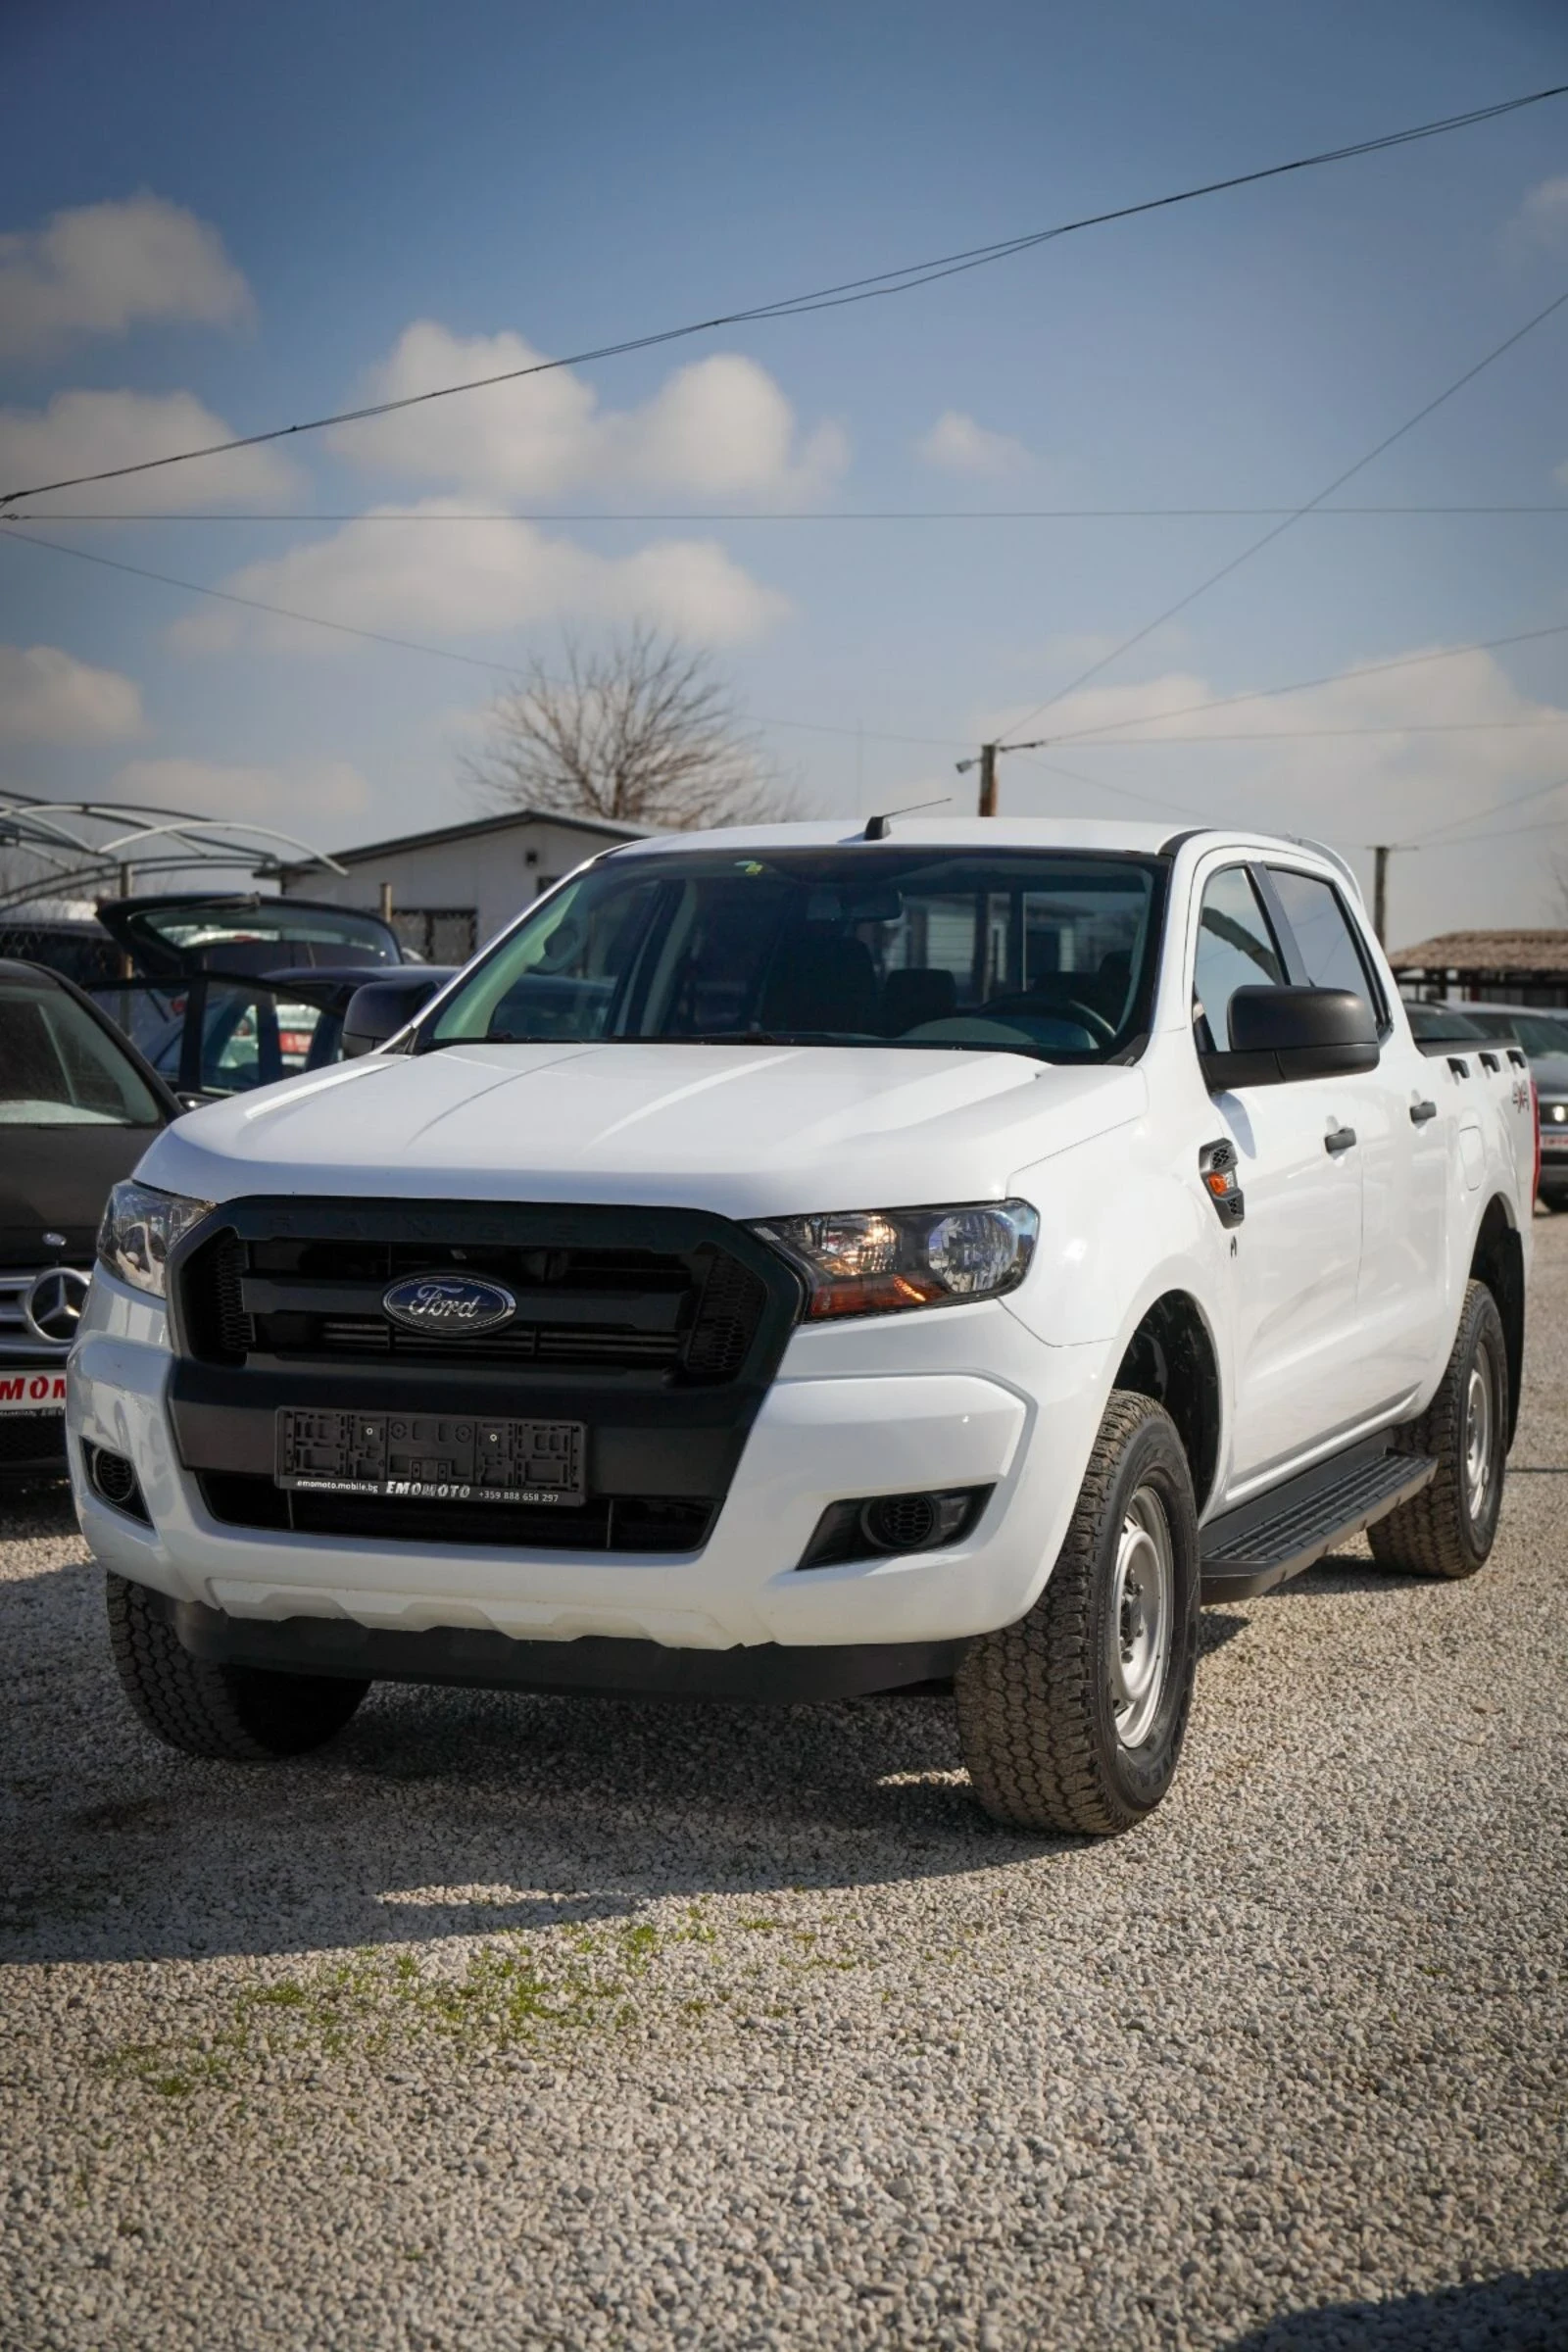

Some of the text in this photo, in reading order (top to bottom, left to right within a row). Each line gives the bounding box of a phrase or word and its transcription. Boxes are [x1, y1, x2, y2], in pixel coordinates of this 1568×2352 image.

[408, 1284, 482, 1318] Ford
[296, 1480, 560, 1503] emomoto.mobile.bg EMOMOTO +359 888 658 297
